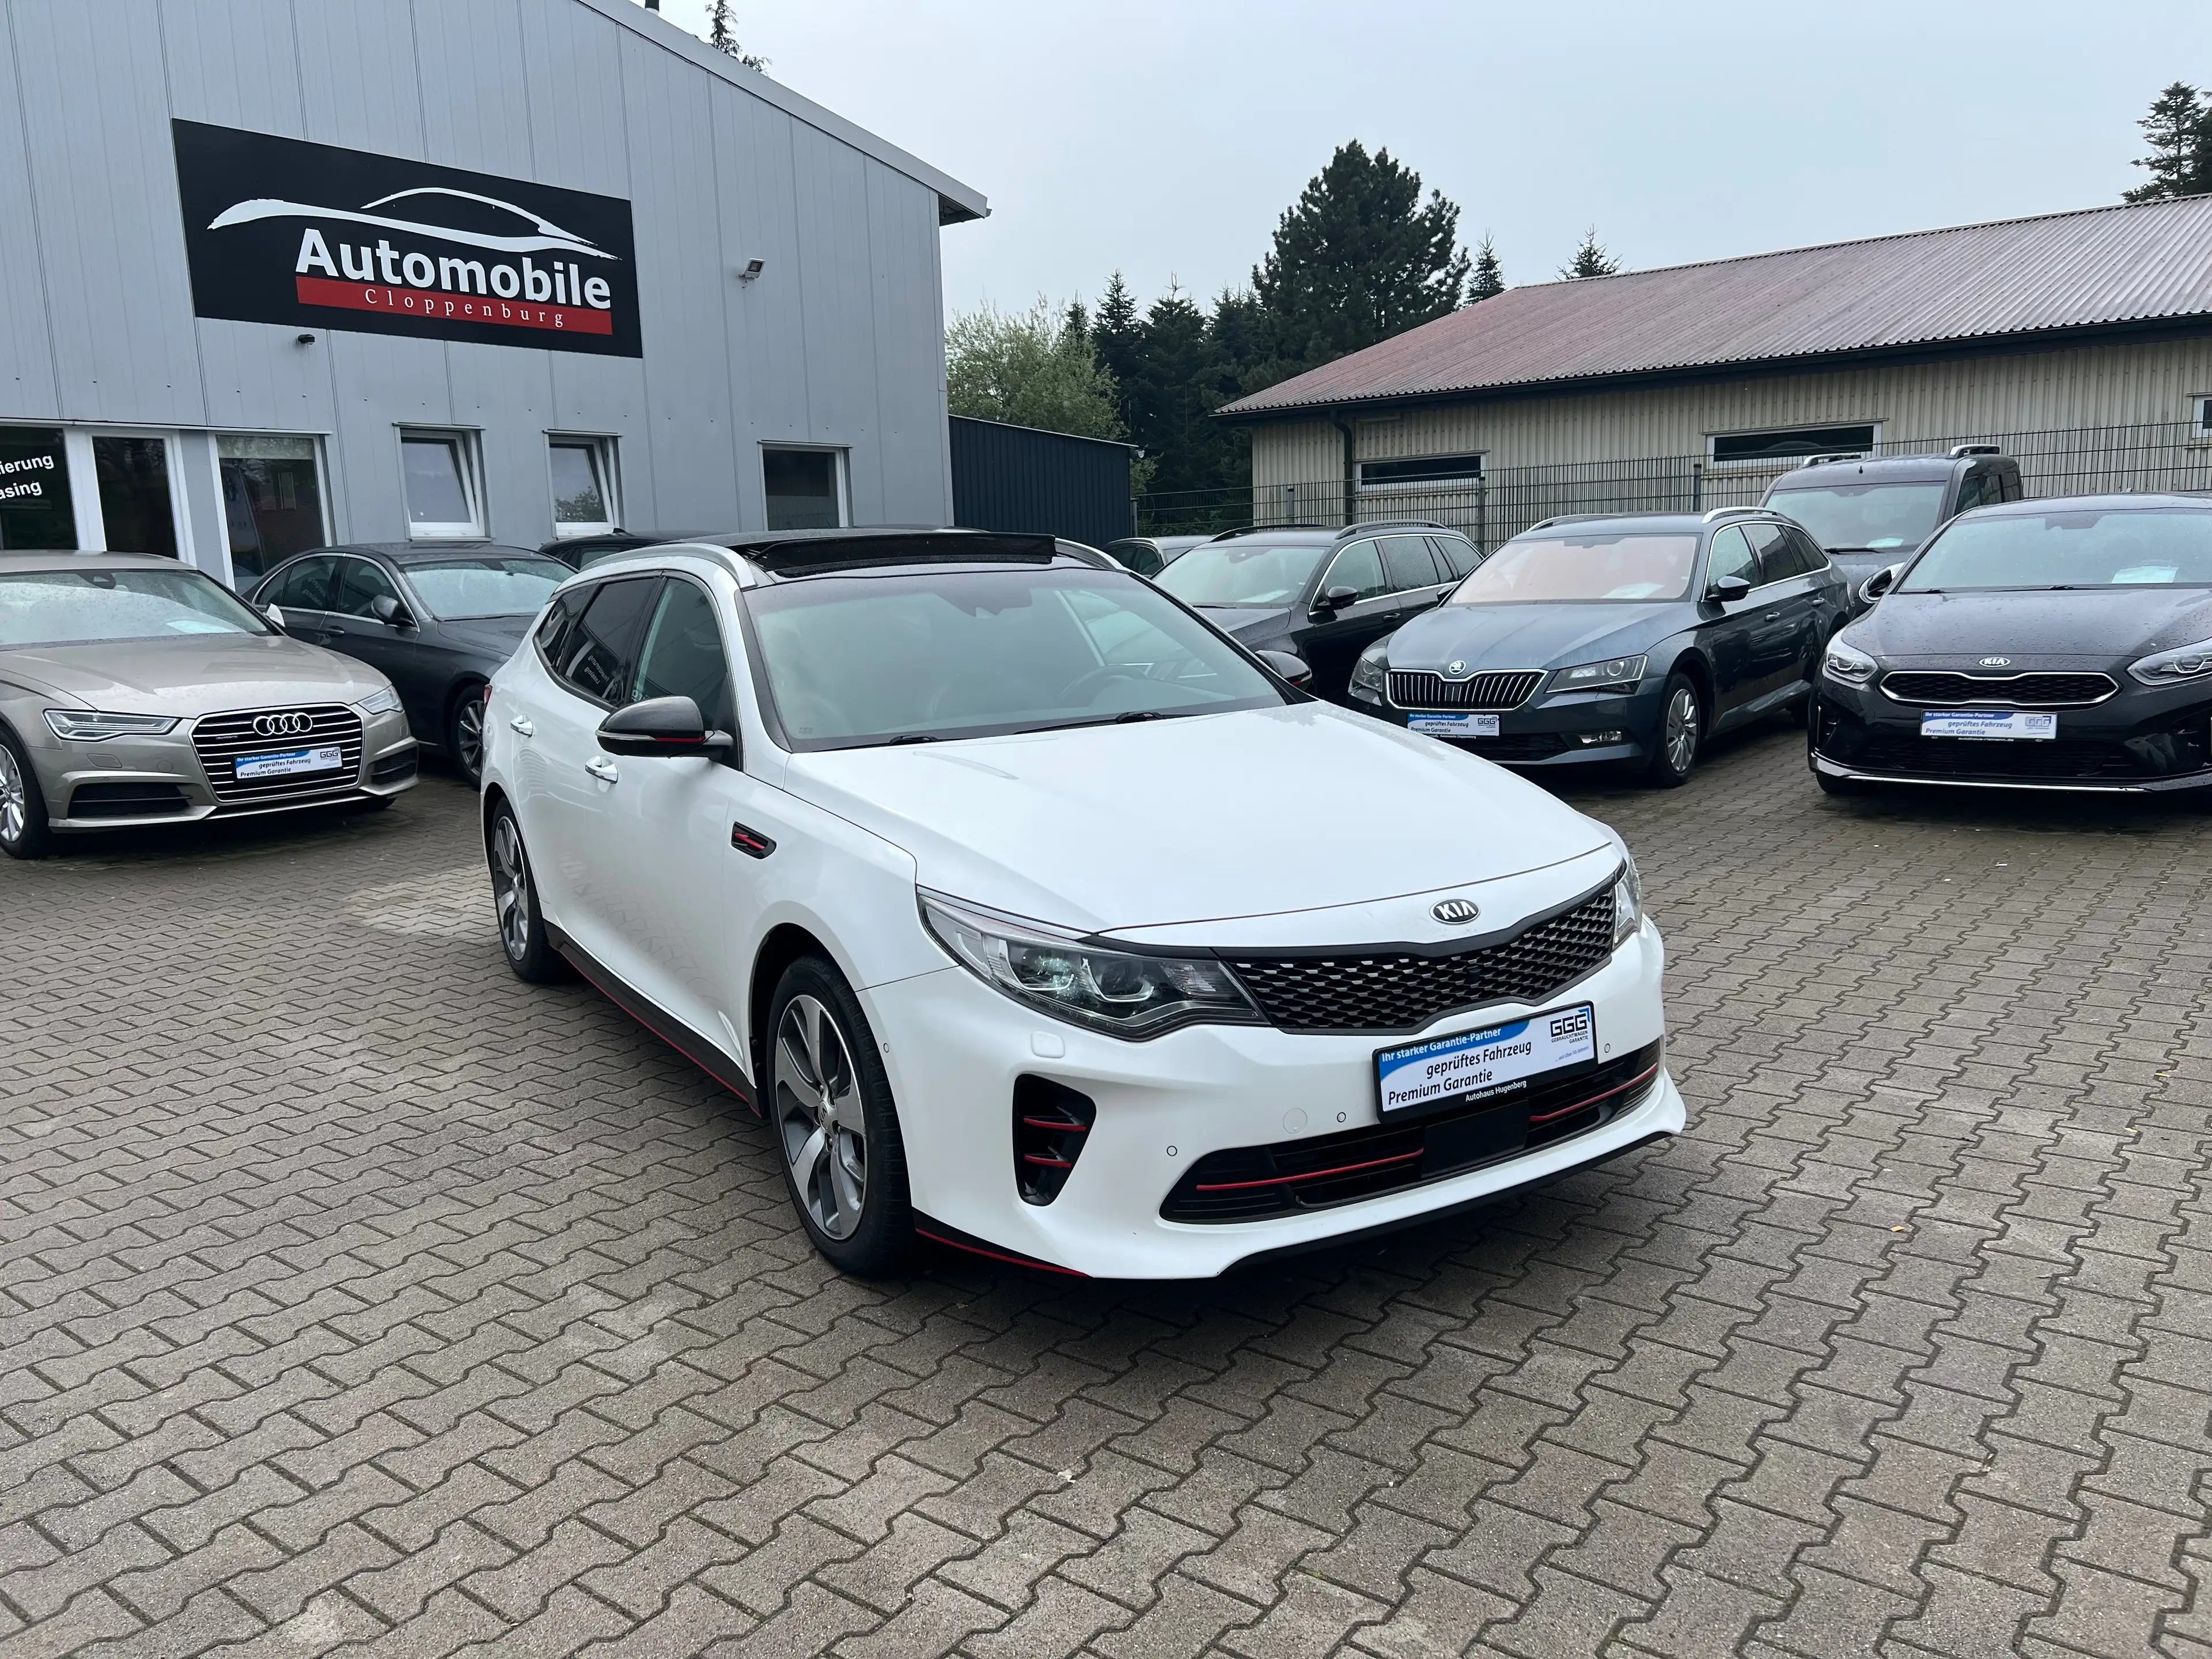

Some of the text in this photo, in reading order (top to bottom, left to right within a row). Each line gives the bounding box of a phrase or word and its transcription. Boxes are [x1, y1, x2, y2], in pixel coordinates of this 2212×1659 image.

[296, 228, 611, 309] Automobile
[365, 289, 564, 328] Cloppenburg
[0, 456, 54, 475] ierung
[320, 750, 339, 758] GGG
[259, 762, 286, 770] geprüftes
[1436, 902, 1476, 919] KIA
[1550, 1013, 1587, 1037] GGG
[1382, 1028, 1502, 1062] Ihr starker Garantie-Partner
[1551, 1030, 1588, 1043] GEBRAUCHTWAGEN
[1569, 1035, 1588, 1044] GARANTIE
[1426, 1040, 1532, 1080] geprüftes Fahrzeug
[1388, 1070, 1493, 1105] Premium Garantie
[1465, 1080, 1527, 1102] Autohaus Hugenberg
